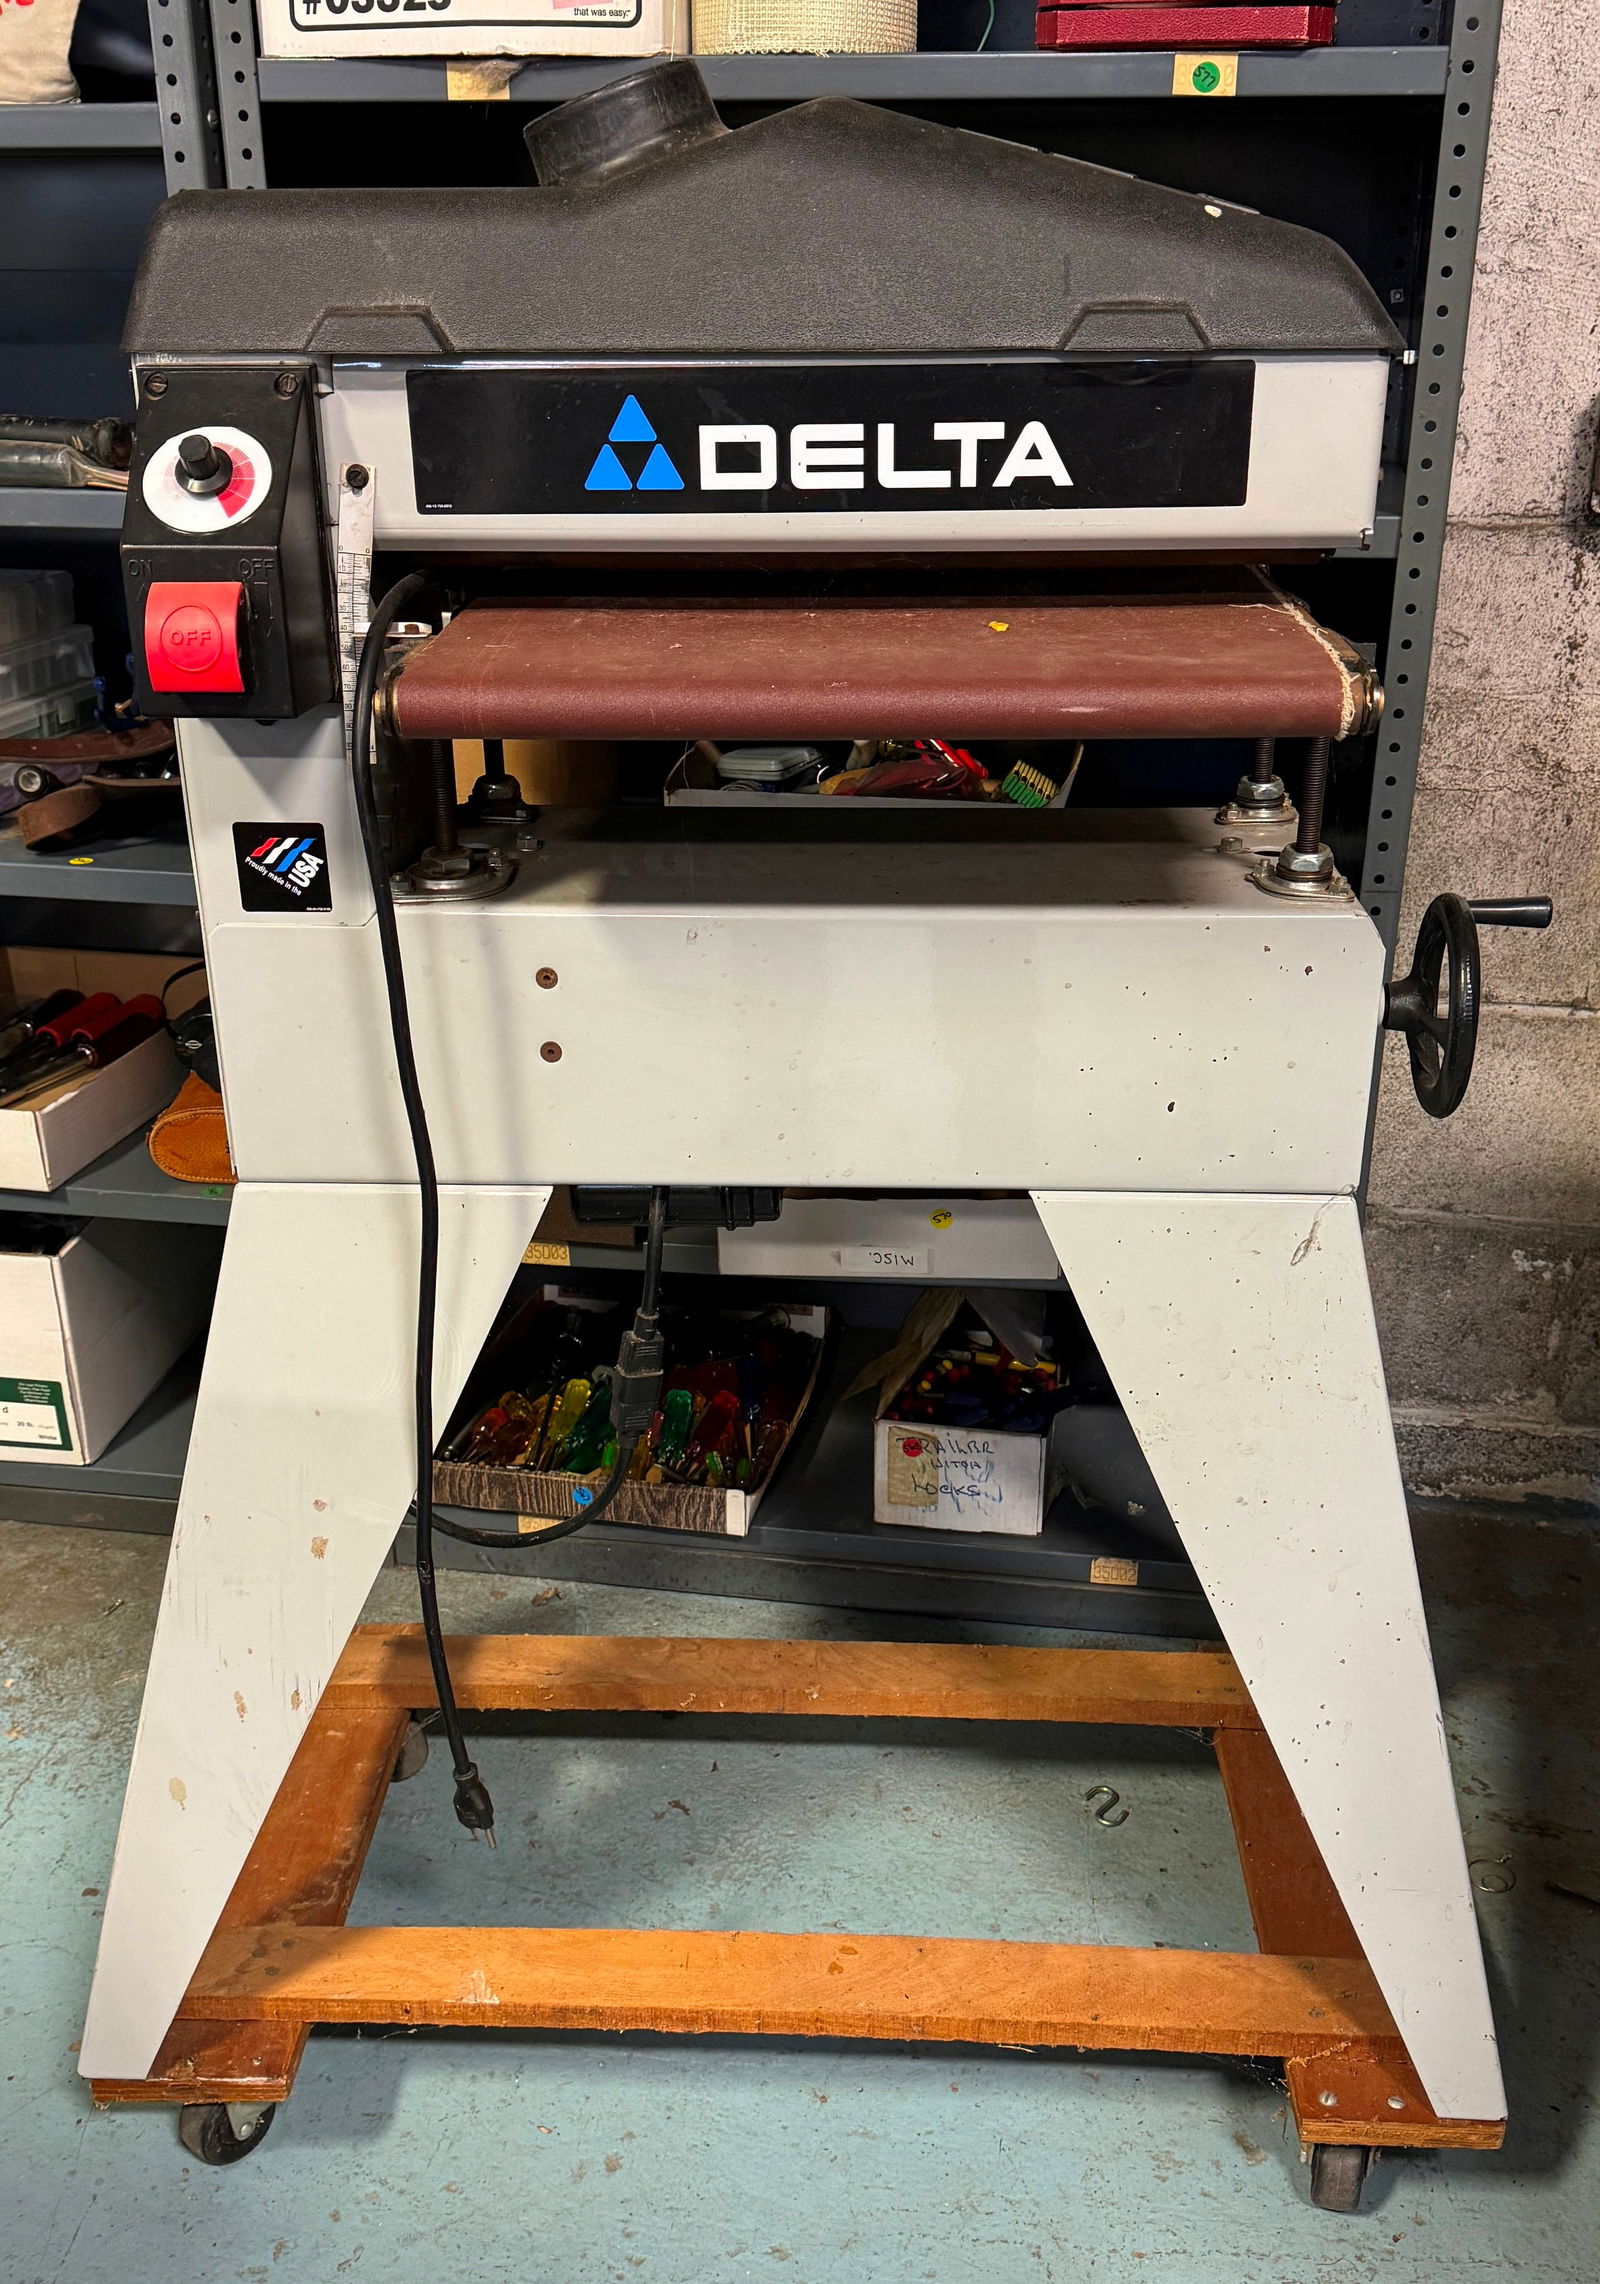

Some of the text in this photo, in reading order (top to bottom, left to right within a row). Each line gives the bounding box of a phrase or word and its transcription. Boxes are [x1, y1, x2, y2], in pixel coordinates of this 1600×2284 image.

[574, 7, 589, 16] that
[591, 9, 607, 17] was
[1194, 65, 1216, 88] 577
[699, 421, 1074, 490] DELTA
[128, 559, 153, 577] ON
[238, 558, 275, 578] OFF
[170, 630, 212, 647] OFF
[245, 856, 302, 896] Proudly made in the
[287, 852, 324, 888] USA
[869, 1252, 914, 1266] MISC.
[912, 1473, 981, 1497] LOCKS
